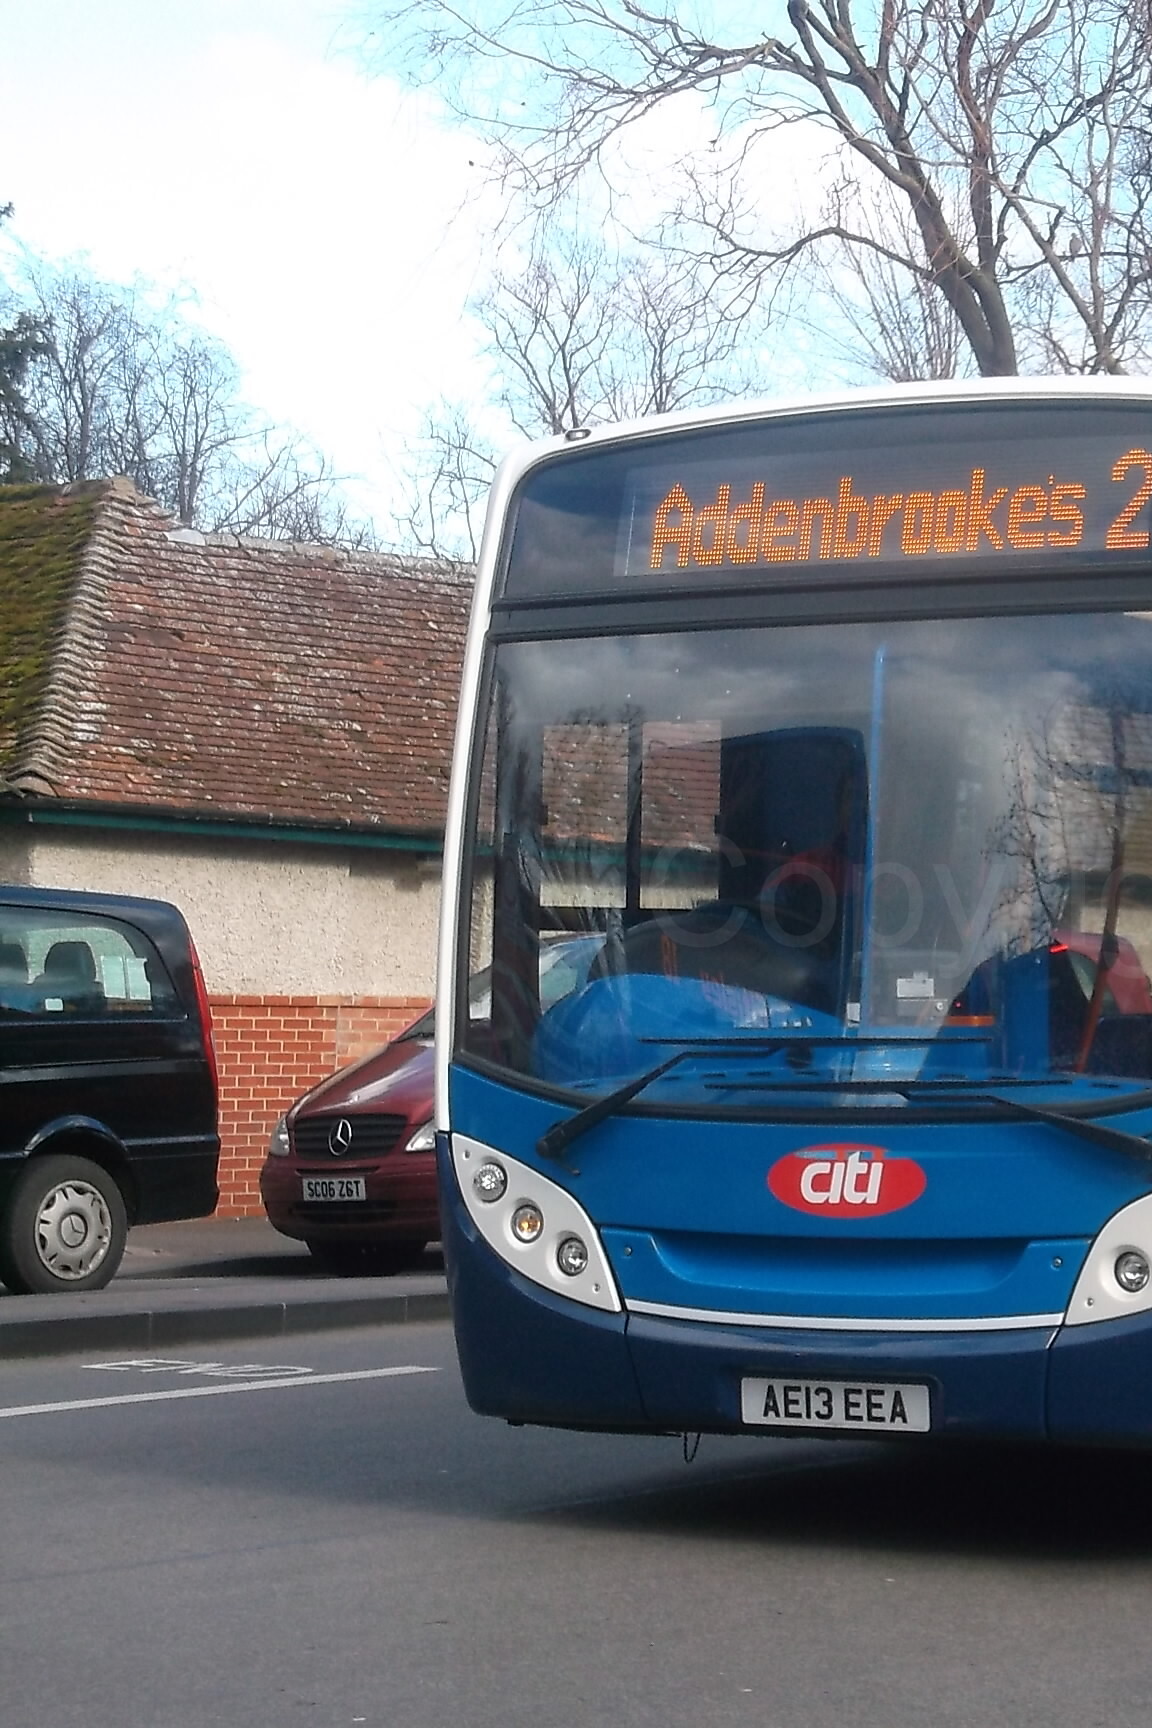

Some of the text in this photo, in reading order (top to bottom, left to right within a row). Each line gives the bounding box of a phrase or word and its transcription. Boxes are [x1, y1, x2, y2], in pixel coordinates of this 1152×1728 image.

[650, 468, 1086, 569] Addenbrooke's
[307, 1181, 335, 1198] SC06
[801, 1151, 883, 1204] citi
[763, 1384, 908, 1424] AE13 EEA
